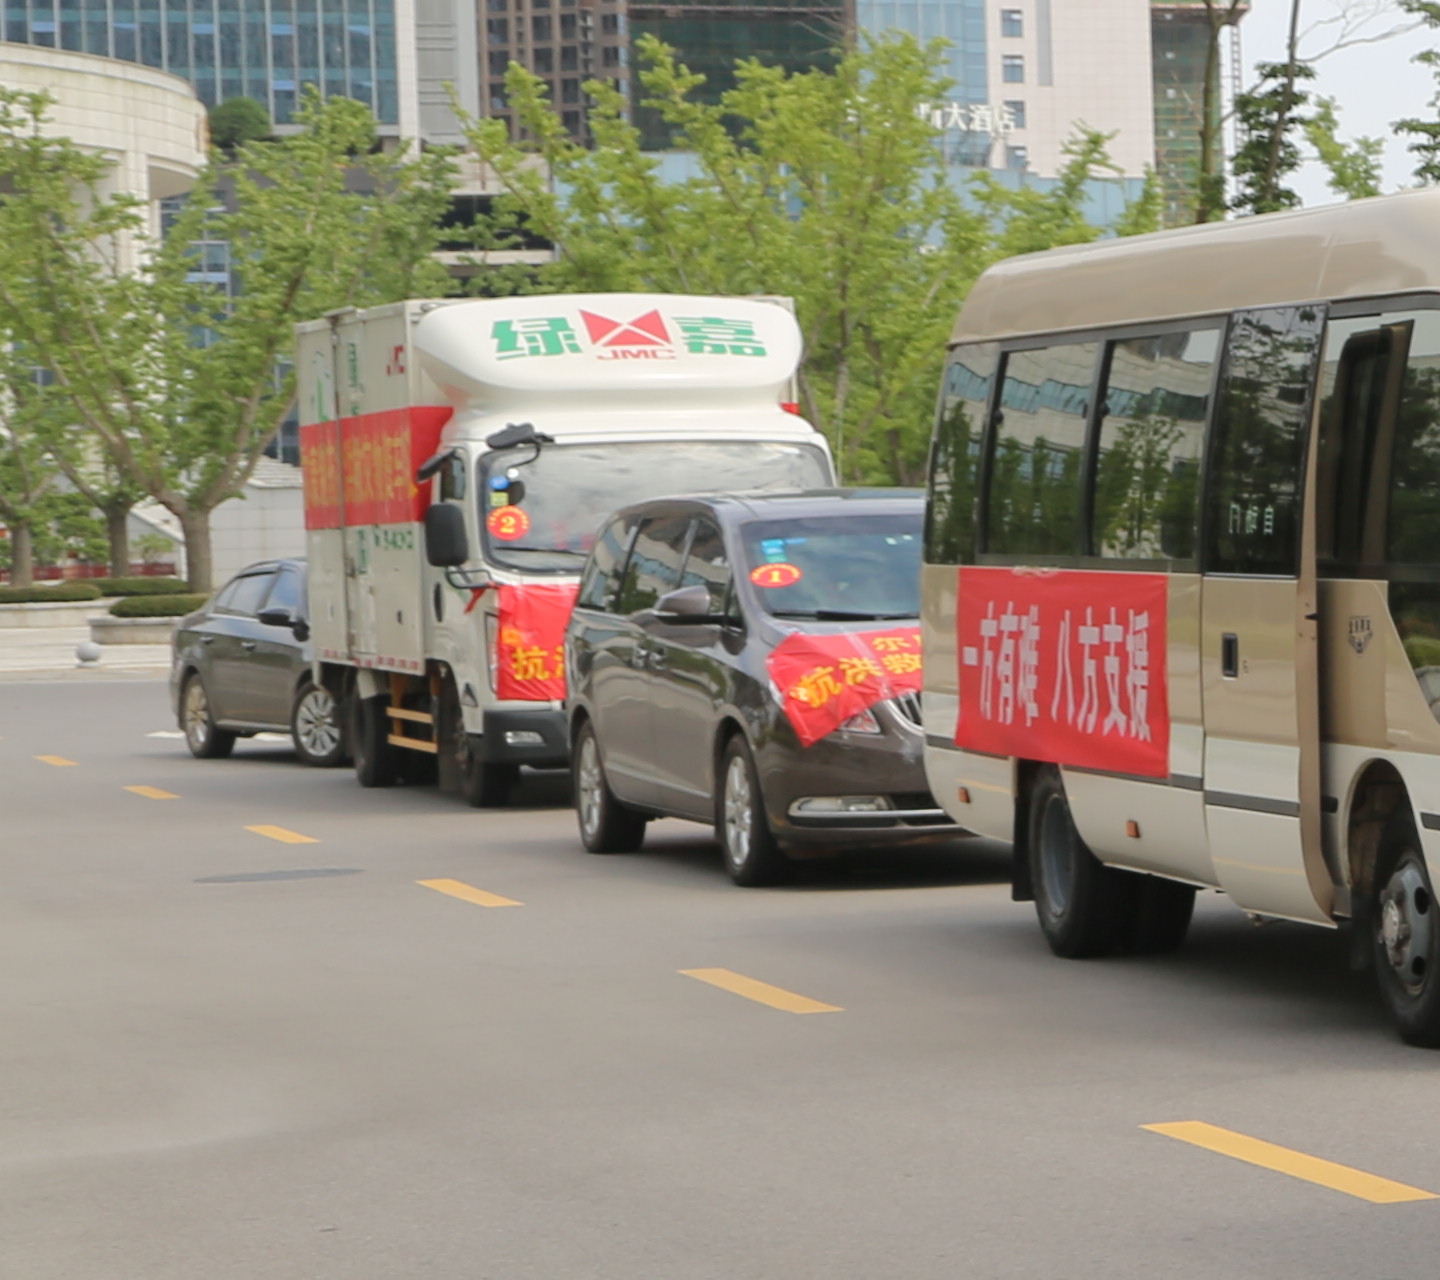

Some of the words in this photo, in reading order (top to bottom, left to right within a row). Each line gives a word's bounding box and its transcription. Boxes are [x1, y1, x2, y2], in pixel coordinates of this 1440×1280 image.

[490, 317, 583, 361] 绿
[597, 349, 677, 360] JMC
[500, 516, 515, 533] 2
[962, 600, 1041, 728] 一方有难
[1051, 605, 1151, 743] 八方支援
